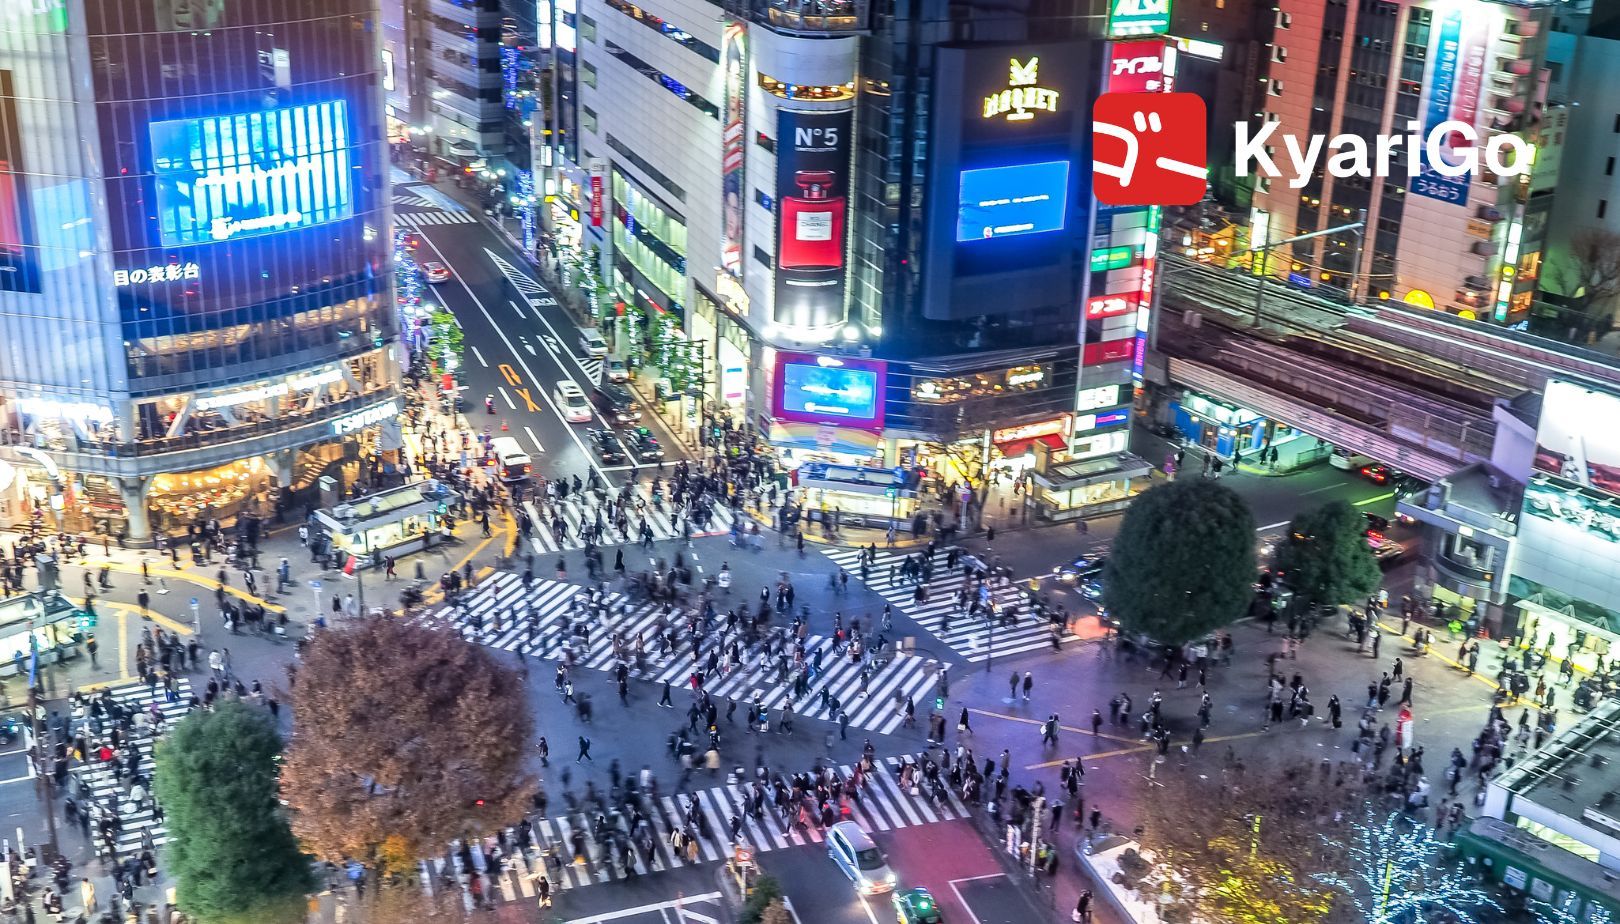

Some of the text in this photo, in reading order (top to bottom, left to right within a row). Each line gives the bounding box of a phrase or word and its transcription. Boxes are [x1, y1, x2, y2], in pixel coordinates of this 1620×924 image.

[113, 262, 200, 287] 目の表彰台
[331, 401, 399, 435] TSUTAYA
